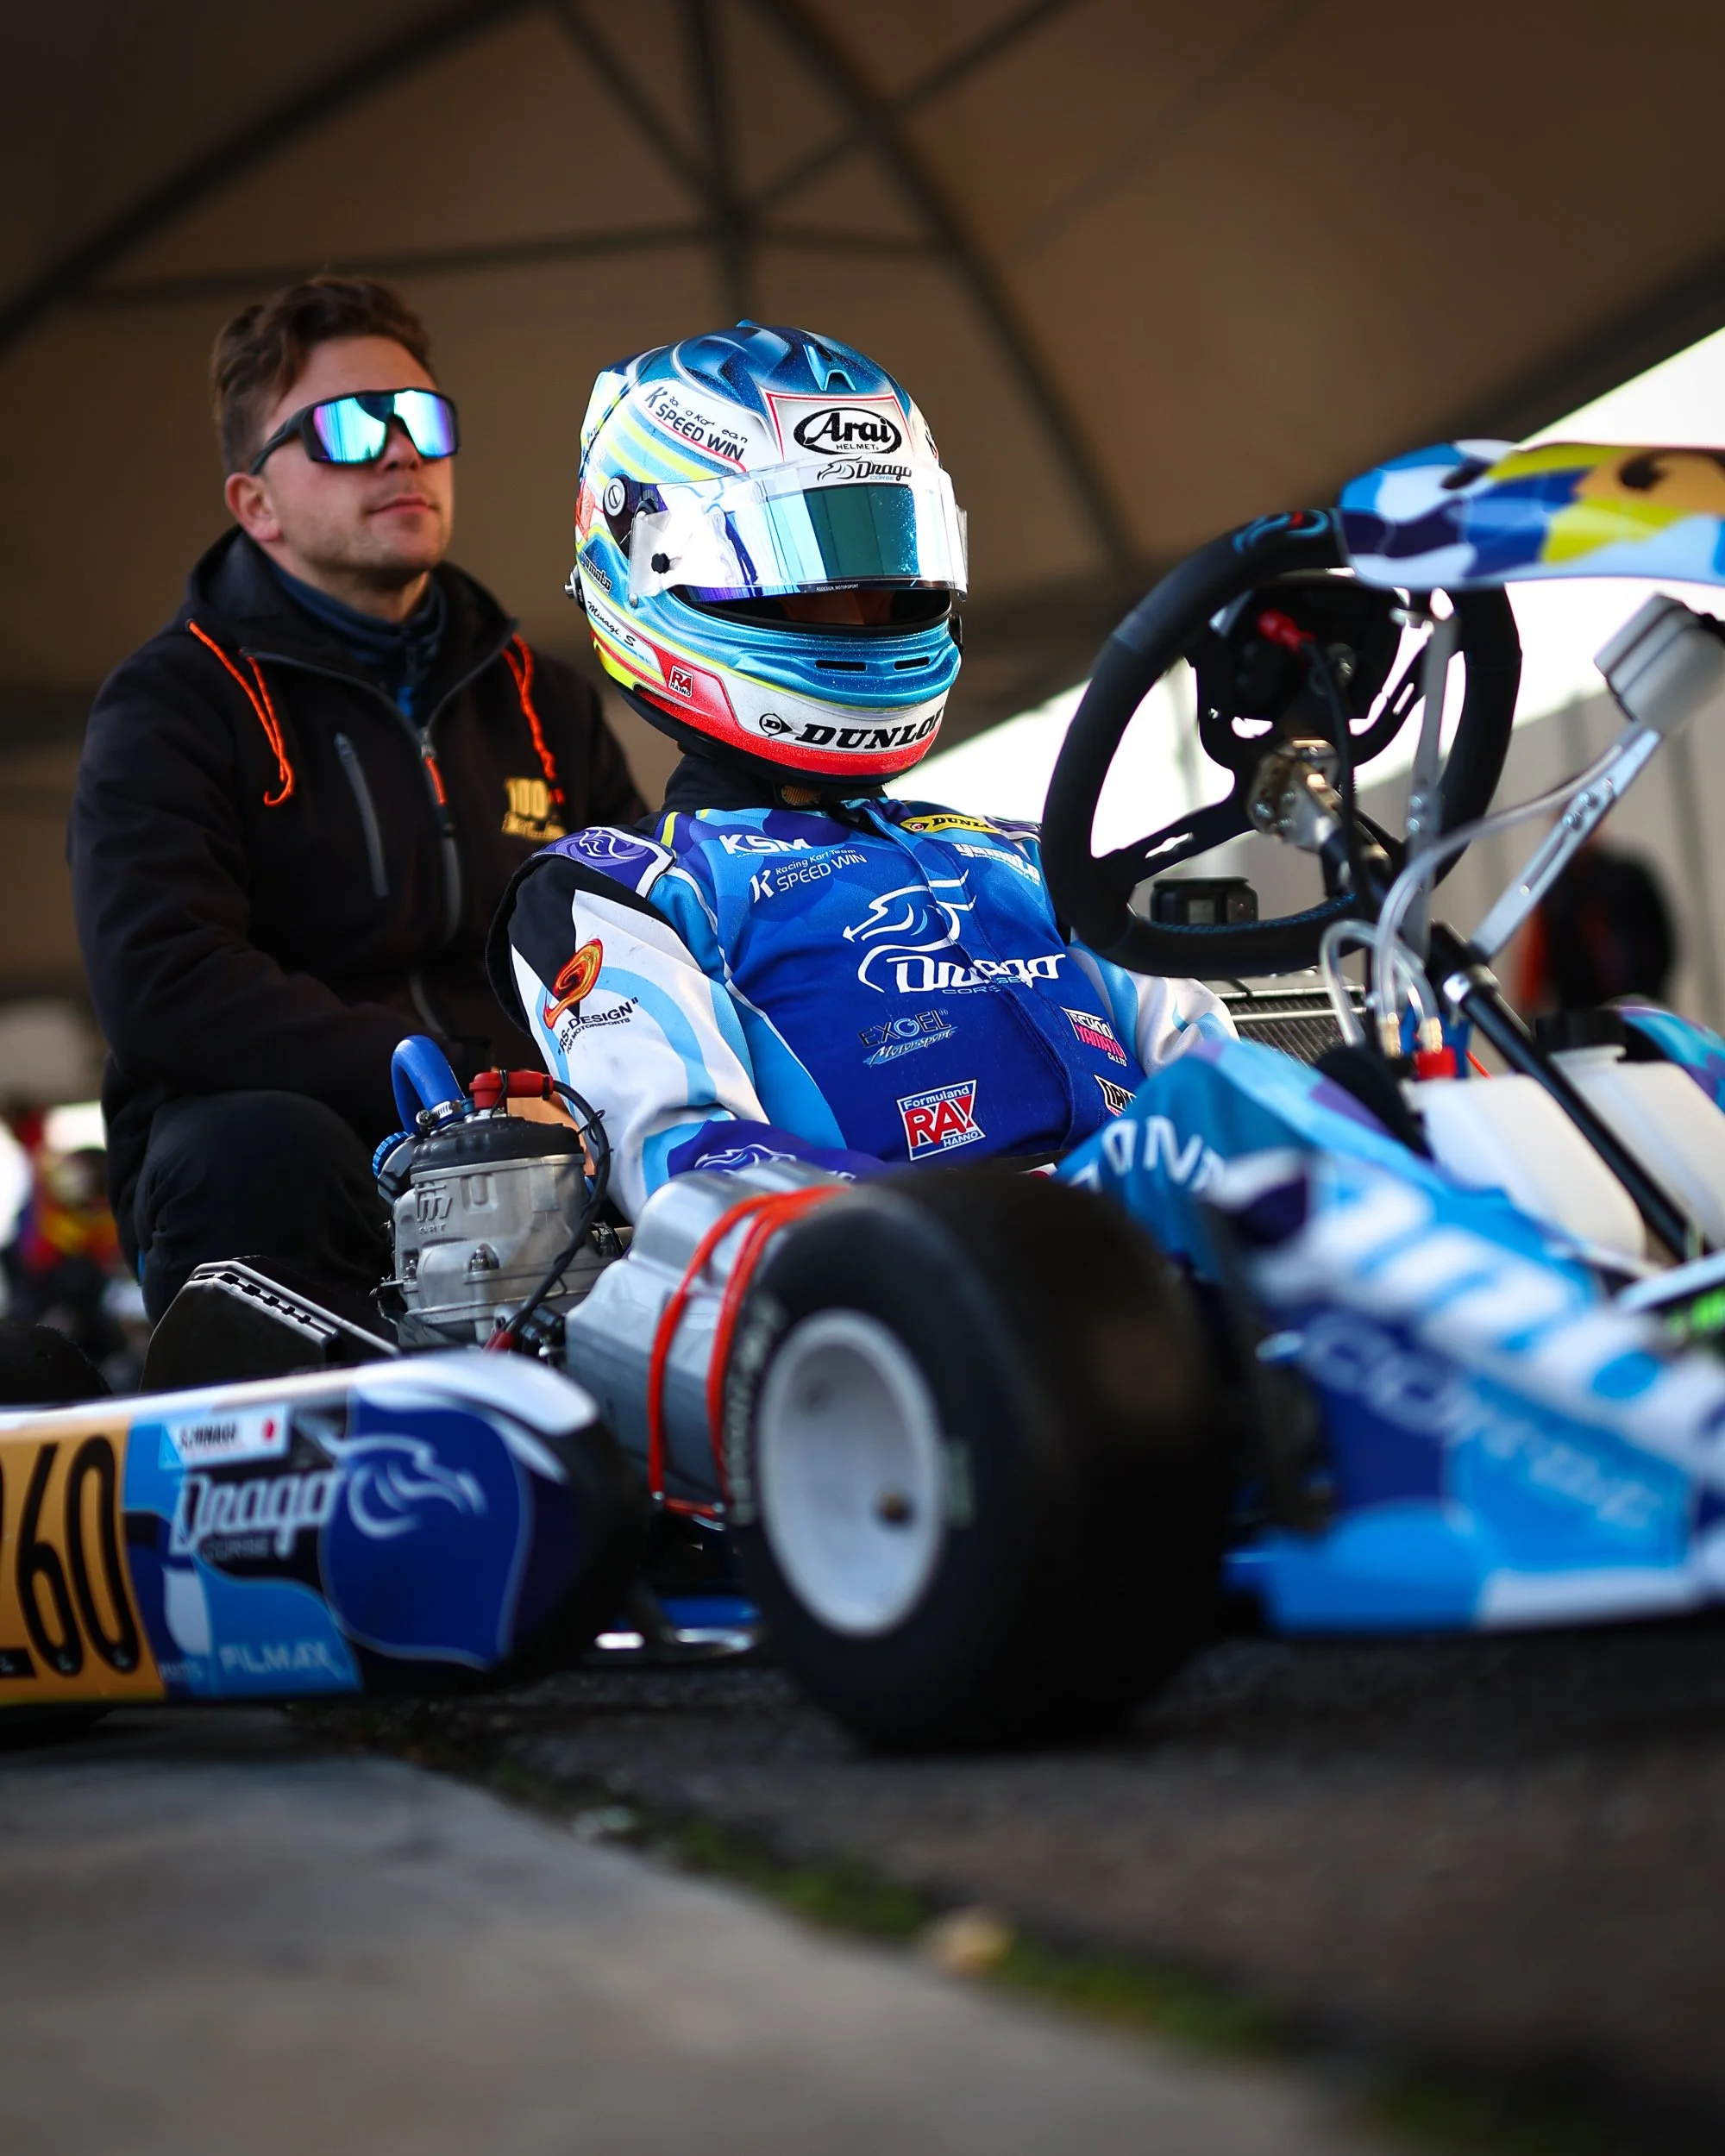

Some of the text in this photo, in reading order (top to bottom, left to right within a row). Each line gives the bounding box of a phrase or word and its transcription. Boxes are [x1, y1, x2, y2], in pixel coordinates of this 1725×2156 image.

[655, 403, 745, 462] SPEED WIN
[804, 411, 893, 446] Arai
[855, 460, 913, 482] Drago
[718, 834, 813, 855] KSM
[775, 859, 809, 875] Racing
[809, 850, 830, 863] Kart
[776, 854, 868, 893] SPEED WIN
[903, 1085, 970, 1111] Formuland
[904, 1094, 975, 1148] RAY
[943, 1131, 980, 1148] HANNO
[169, 1470, 347, 1557] Drago
